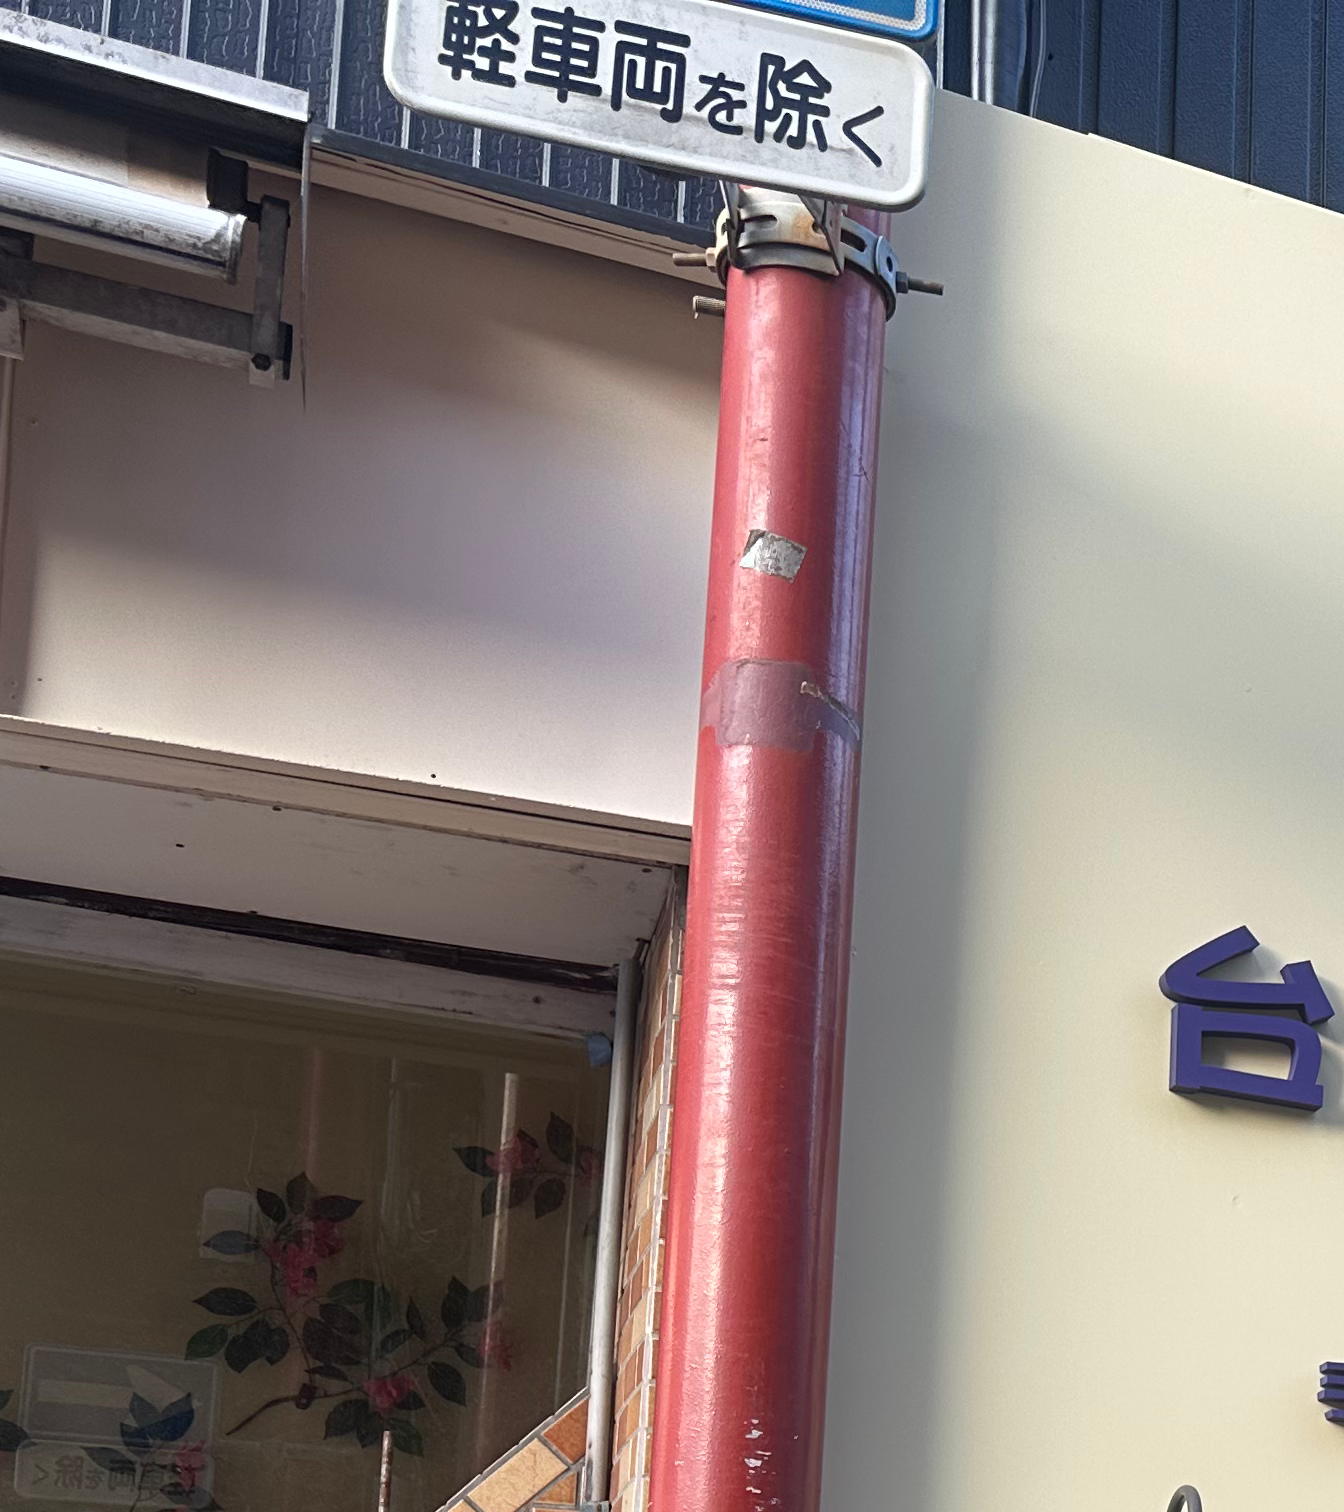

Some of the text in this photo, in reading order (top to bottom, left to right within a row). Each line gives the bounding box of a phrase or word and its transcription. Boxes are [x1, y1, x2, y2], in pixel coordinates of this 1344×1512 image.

[437, 0, 885, 168] 軽車両を除く
